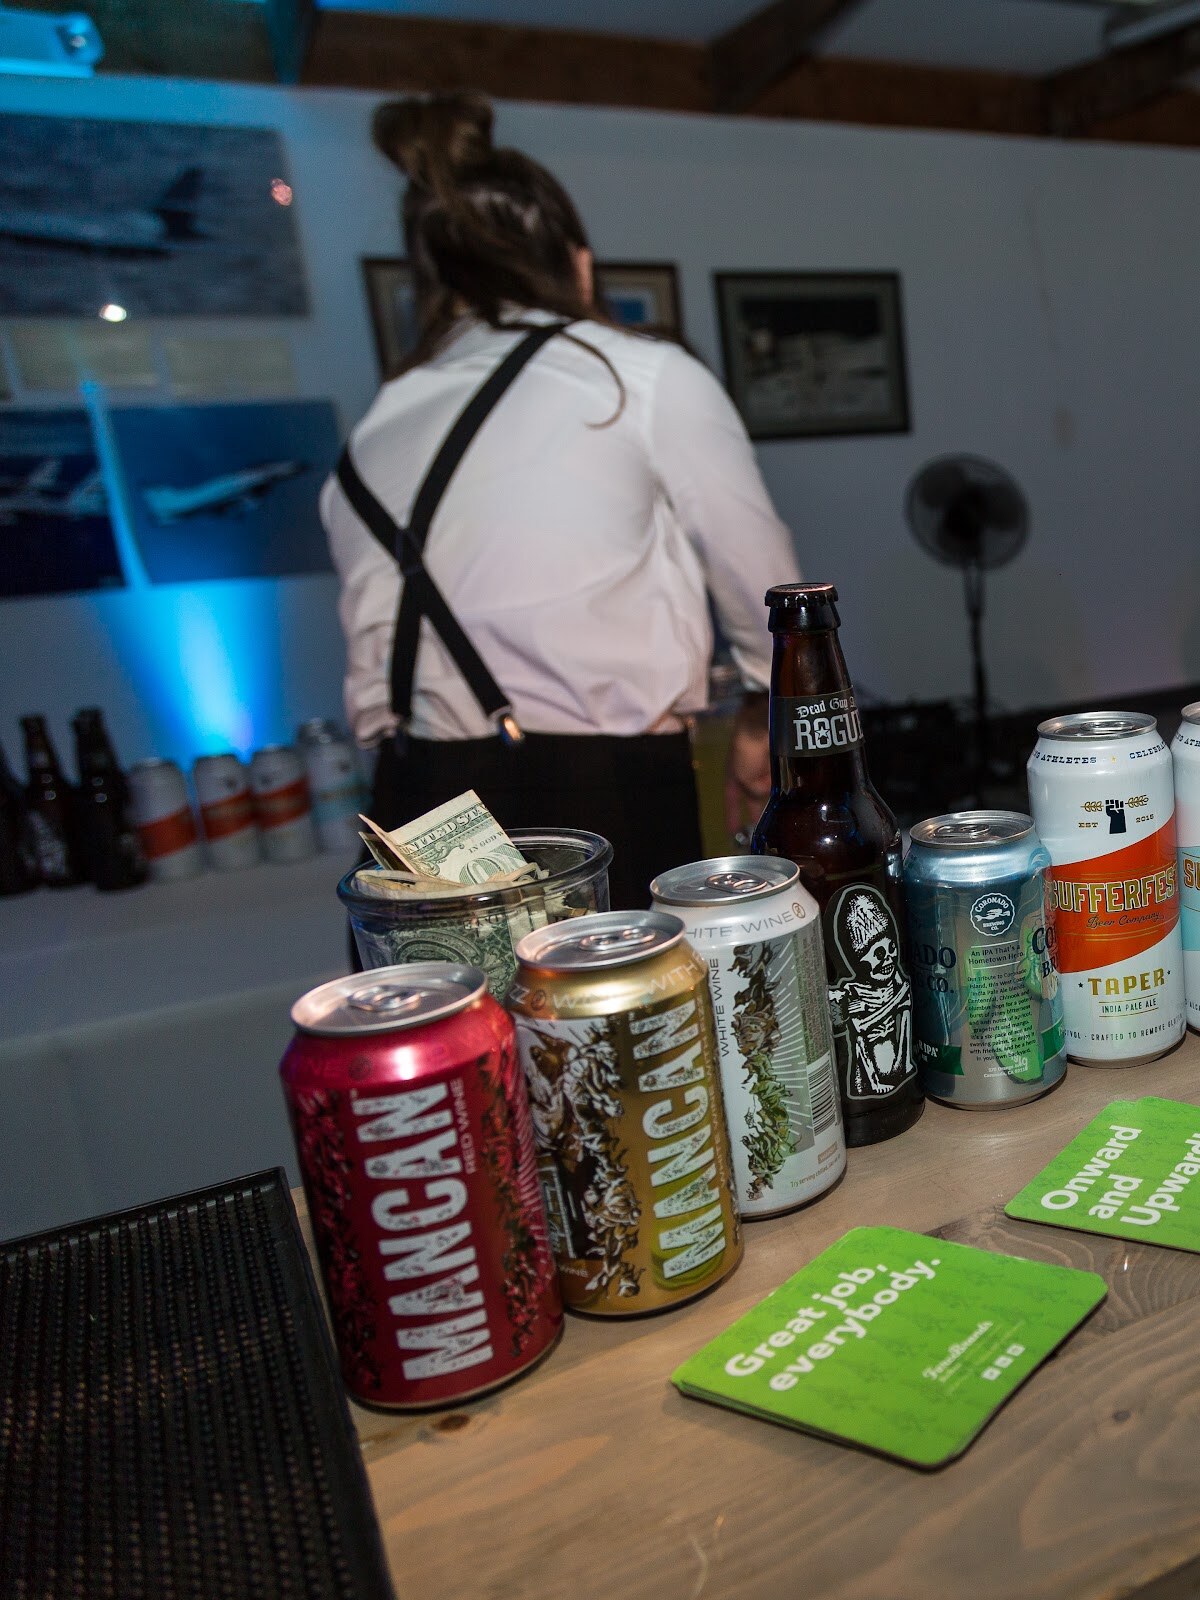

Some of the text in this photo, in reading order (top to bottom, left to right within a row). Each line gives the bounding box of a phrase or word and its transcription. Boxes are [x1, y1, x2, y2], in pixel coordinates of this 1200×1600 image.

[796, 701, 826, 719] Dead
[1040, 753, 1097, 764] ATHLETES
[480, 835, 497, 846] GOD
[975, 897, 1009, 912] CORONADO
[741, 911, 795, 935] WINE
[1086, 911, 1164, 928] Beer Company
[969, 955, 1006, 964] Hometown
[995, 945, 1015, 953] That's
[644, 962, 697, 996] WITH
[1087, 967, 1165, 996] TAPER
[709, 957, 729, 1057] WHITE WINE
[1102, 998, 1157, 1014] INDIA PALE ALE
[1128, 1031, 1137, 1039] TO
[1141, 1024, 1165, 1037] REMOVE
[450, 1077, 477, 1175] RED WINE
[629, 999, 727, 1279] MANCAN
[1040, 1125, 1143, 1210] Onward
[1088, 1174, 1144, 1220] and
[350, 1081, 495, 1381] MANCAN
[768, 1257, 941, 1392] everybody.
[724, 1306, 827, 1377] Great
